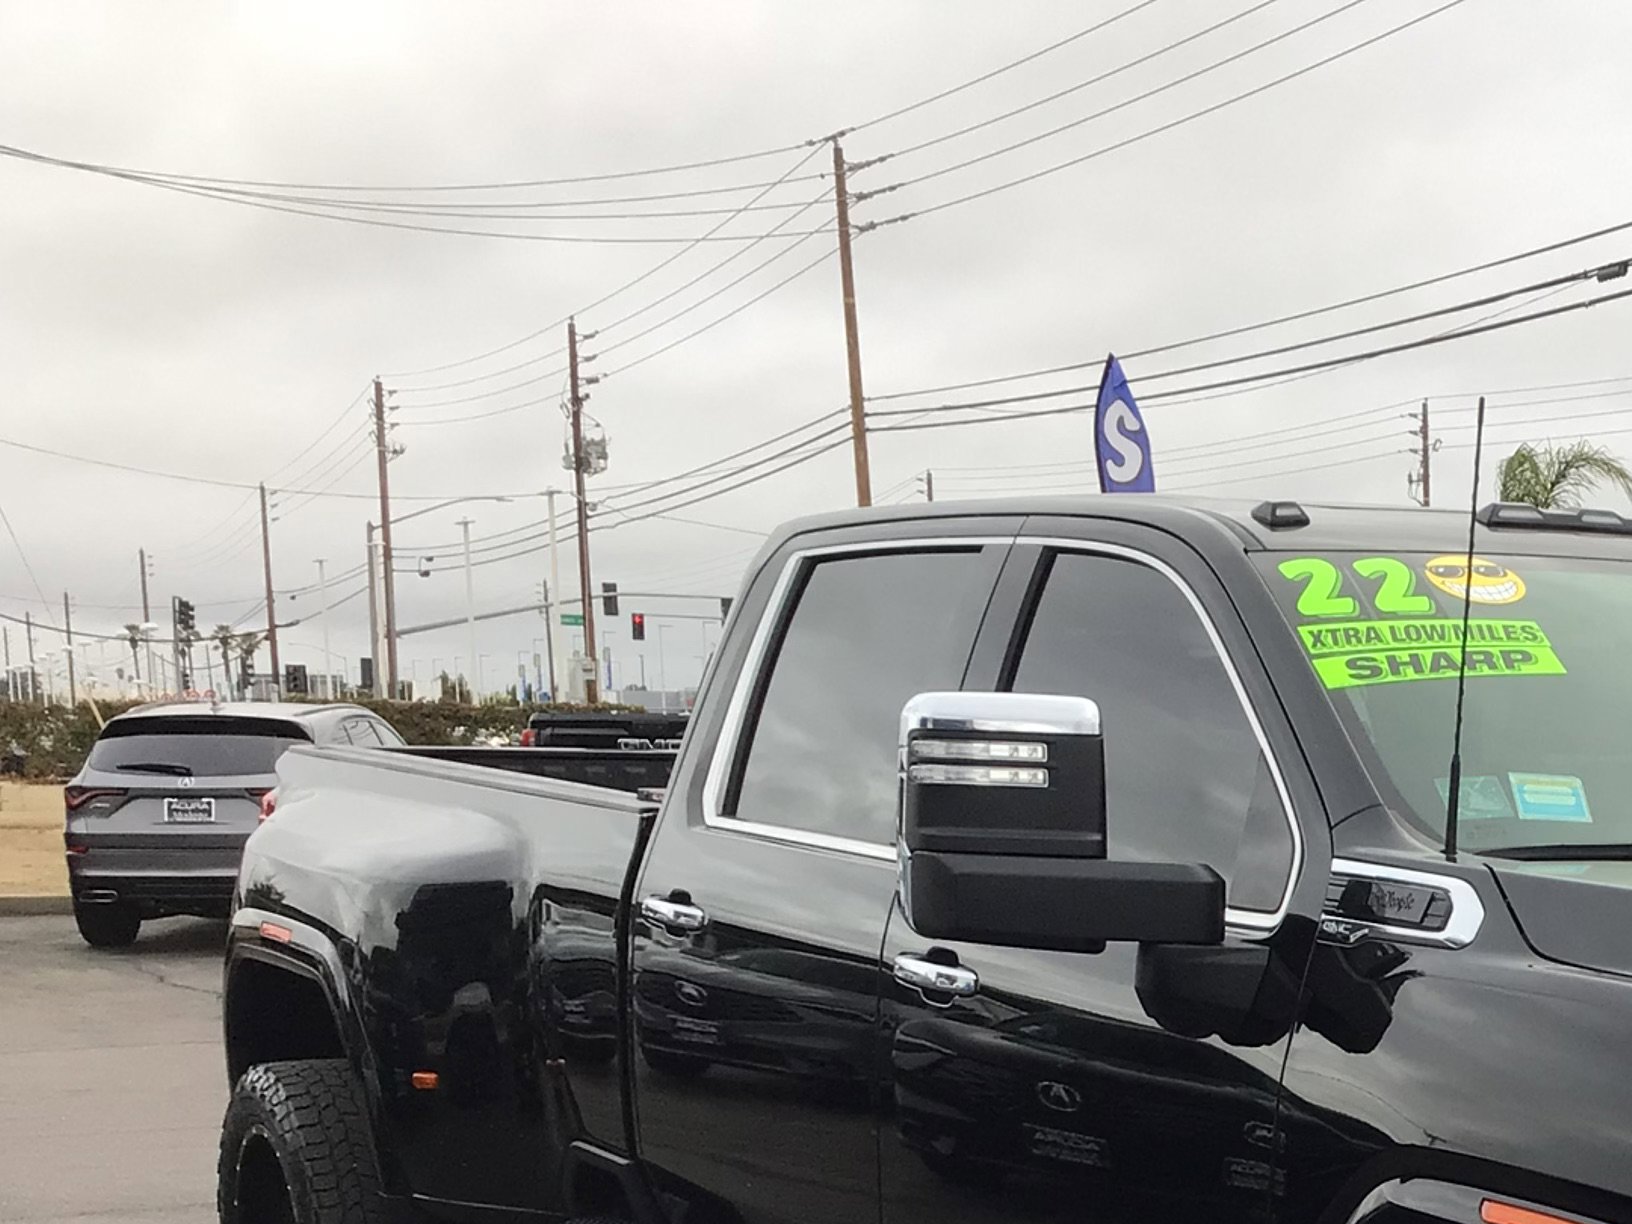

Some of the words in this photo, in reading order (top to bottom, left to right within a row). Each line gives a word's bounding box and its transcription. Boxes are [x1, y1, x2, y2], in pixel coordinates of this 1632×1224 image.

[1104, 399, 1143, 483] S
[1277, 557, 1436, 617] 22
[1310, 625, 1384, 650] XTRA
[1389, 624, 1451, 647] LOW
[1453, 624, 1540, 646] MILES
[1345, 650, 1538, 681] SHARP
